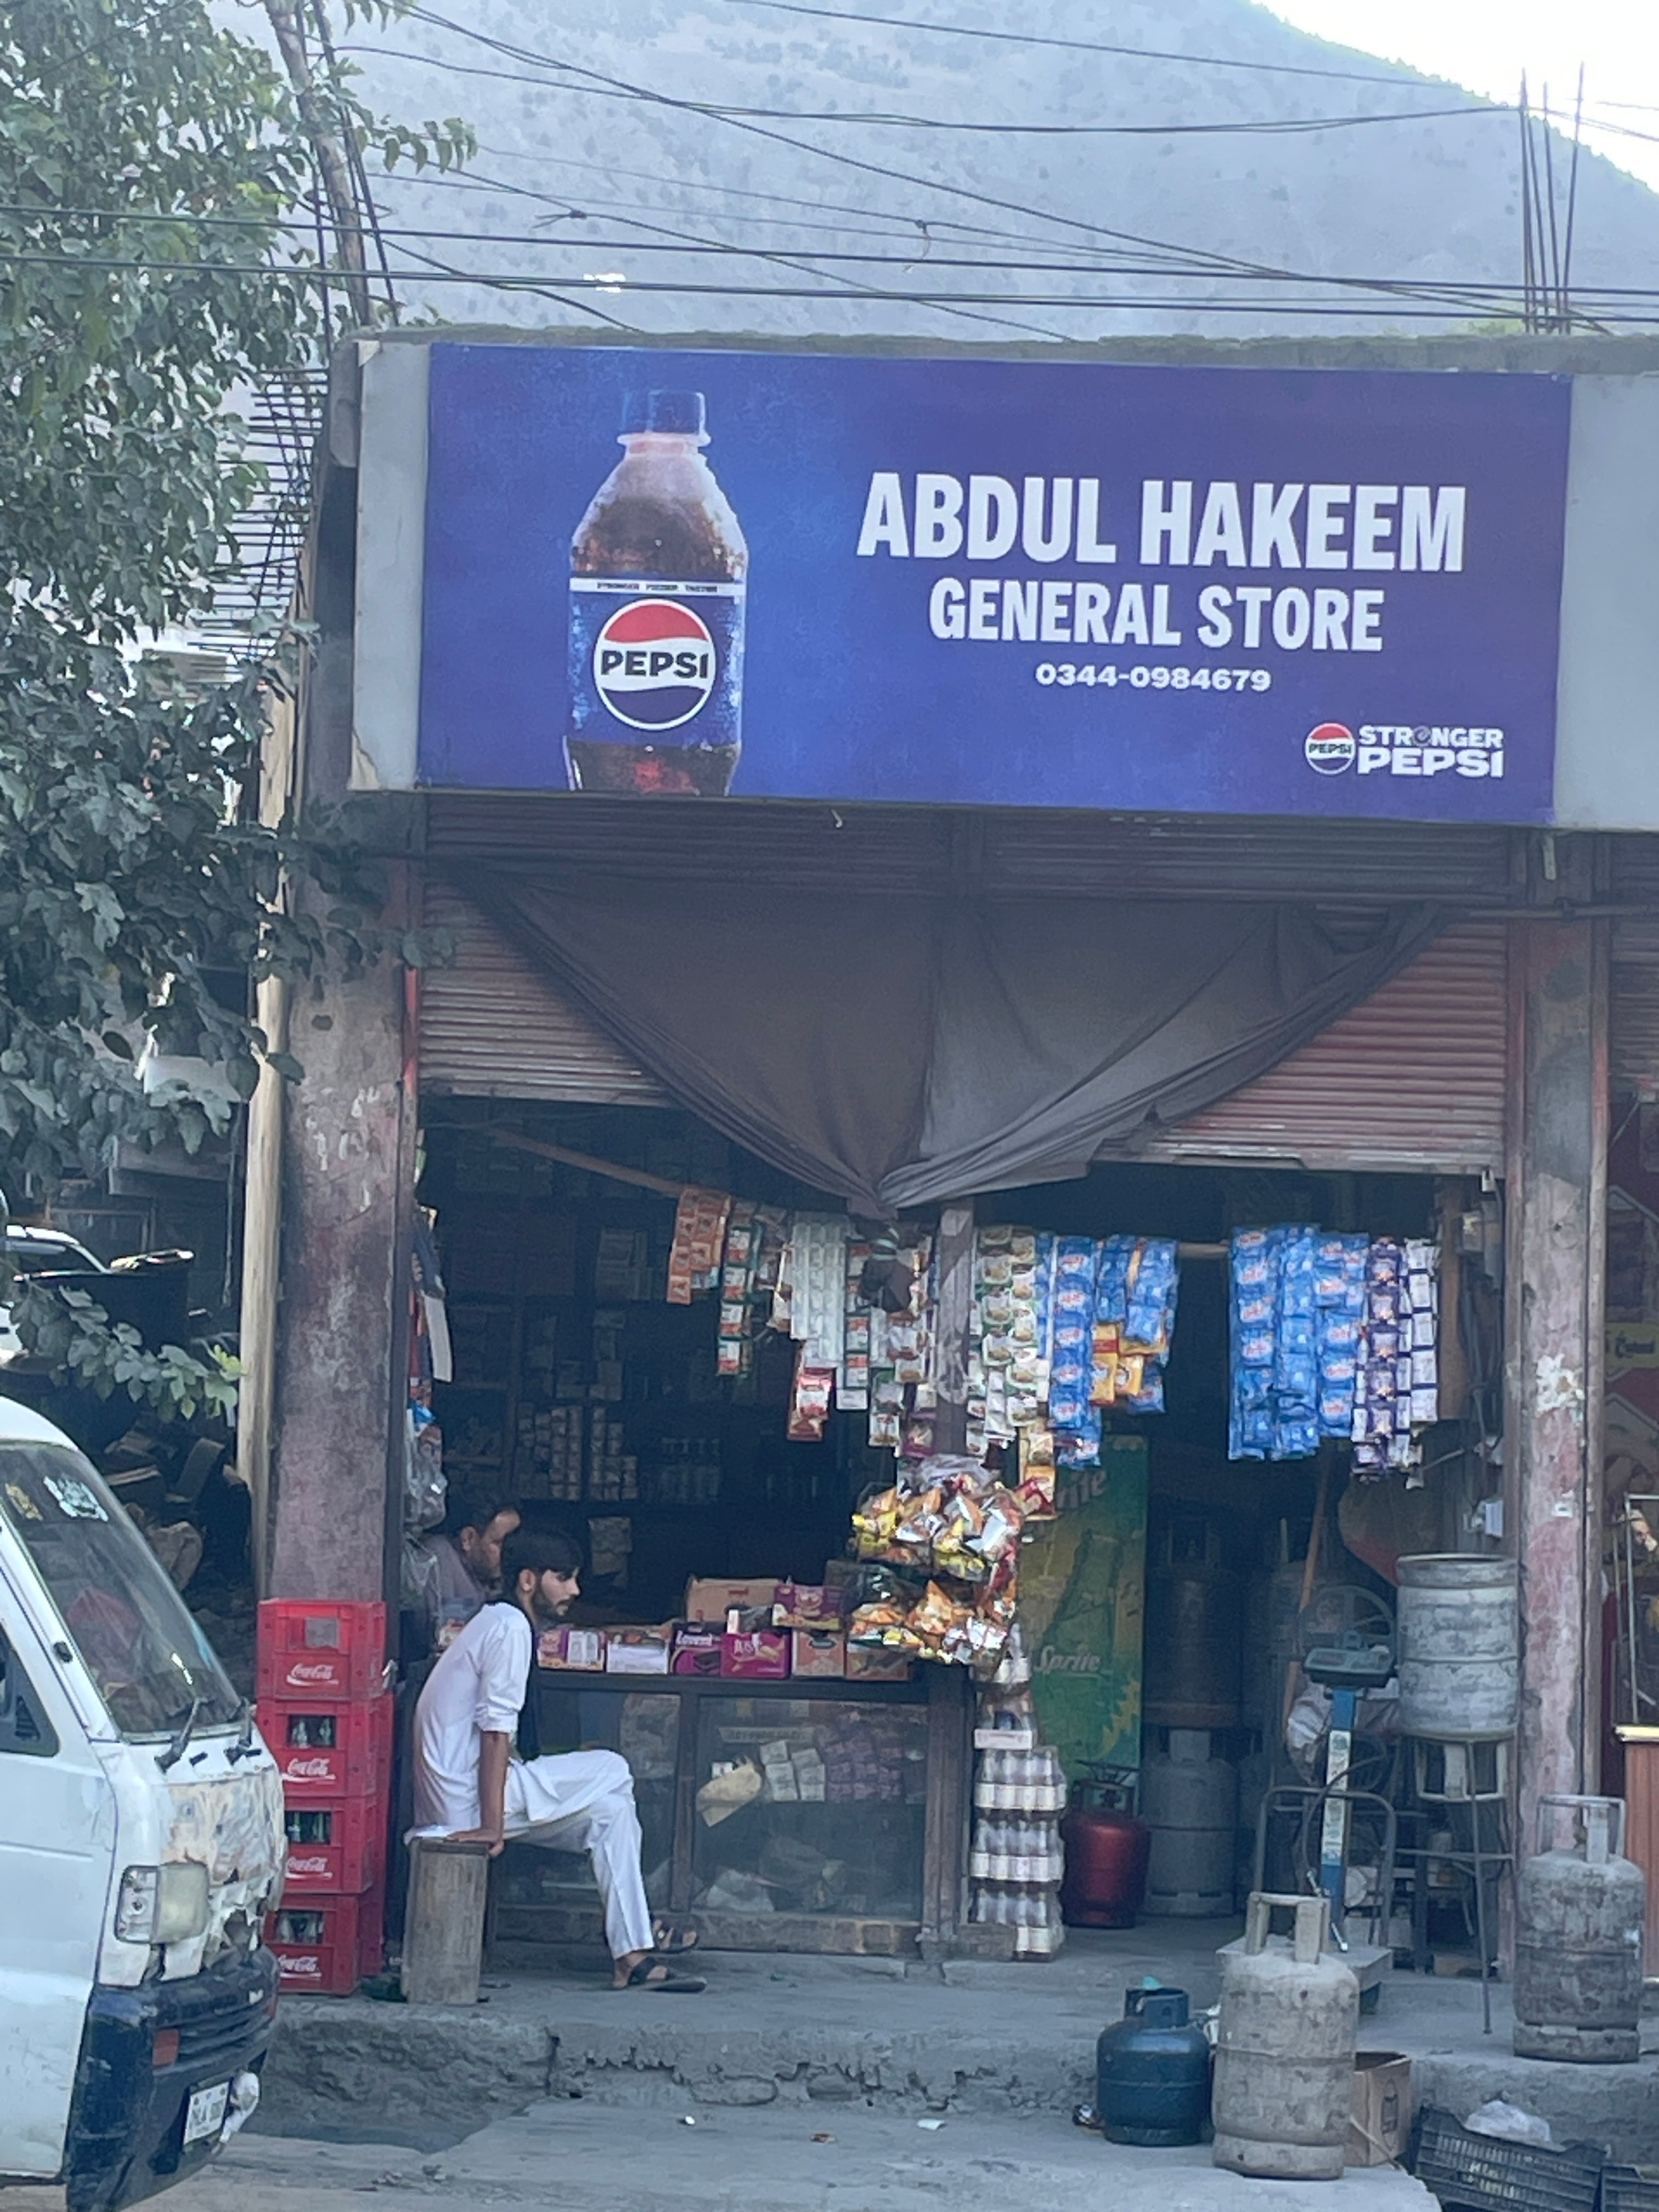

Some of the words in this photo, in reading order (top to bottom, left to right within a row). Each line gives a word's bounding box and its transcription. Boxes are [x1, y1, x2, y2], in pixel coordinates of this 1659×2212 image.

[856, 472, 1117, 564] ABDUL
[1140, 480, 1466, 573] HAKEEM
[930, 578, 1182, 647] GENERAL
[1198, 585, 1385, 652] STORE
[601, 650, 709, 680] PEPSI
[1036, 663, 1272, 692] 0344-0984679
[1308, 743, 1352, 754] PEPSI
[1358, 725, 1504, 748] STRONGER
[1357, 747, 1504, 778] PEPSI
[1034, 1645, 1101, 1675] Sprite
